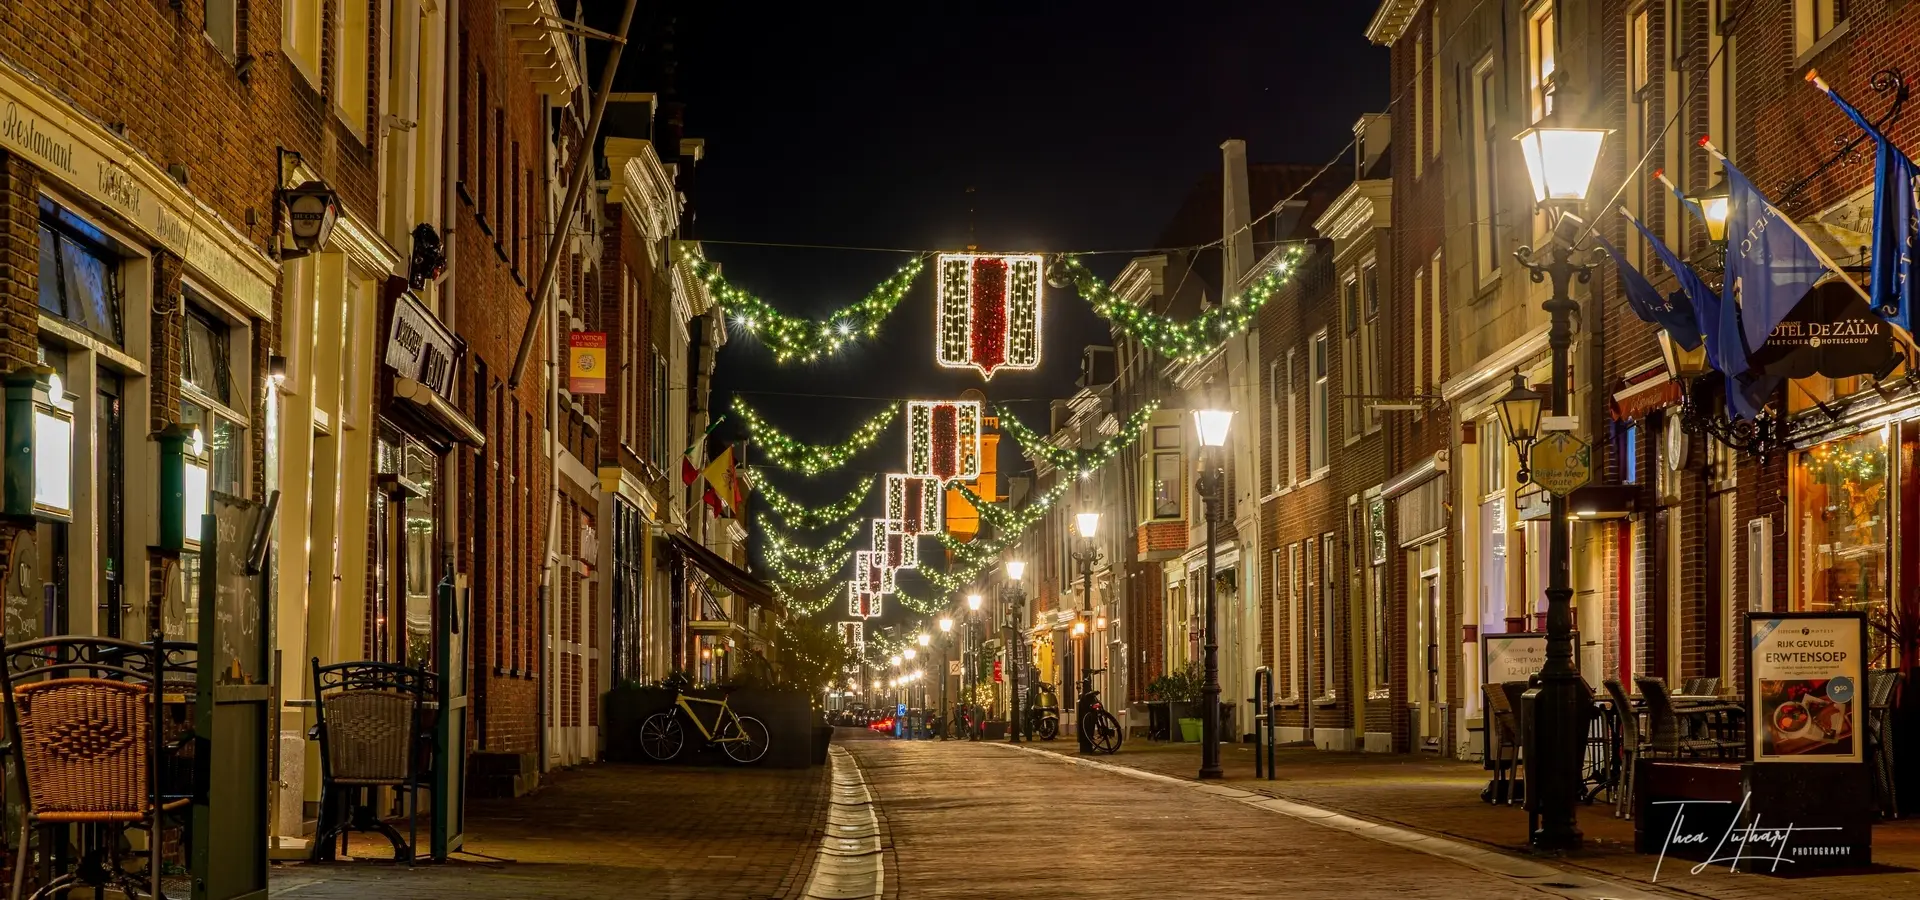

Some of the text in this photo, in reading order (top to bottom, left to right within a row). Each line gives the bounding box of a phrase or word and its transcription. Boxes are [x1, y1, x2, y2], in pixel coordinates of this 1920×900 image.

[1832, 321, 1879, 336] ZALM
[1796, 640, 1835, 648] GEVULDE
[1765, 651, 1847, 663] ERWTENSOEP
